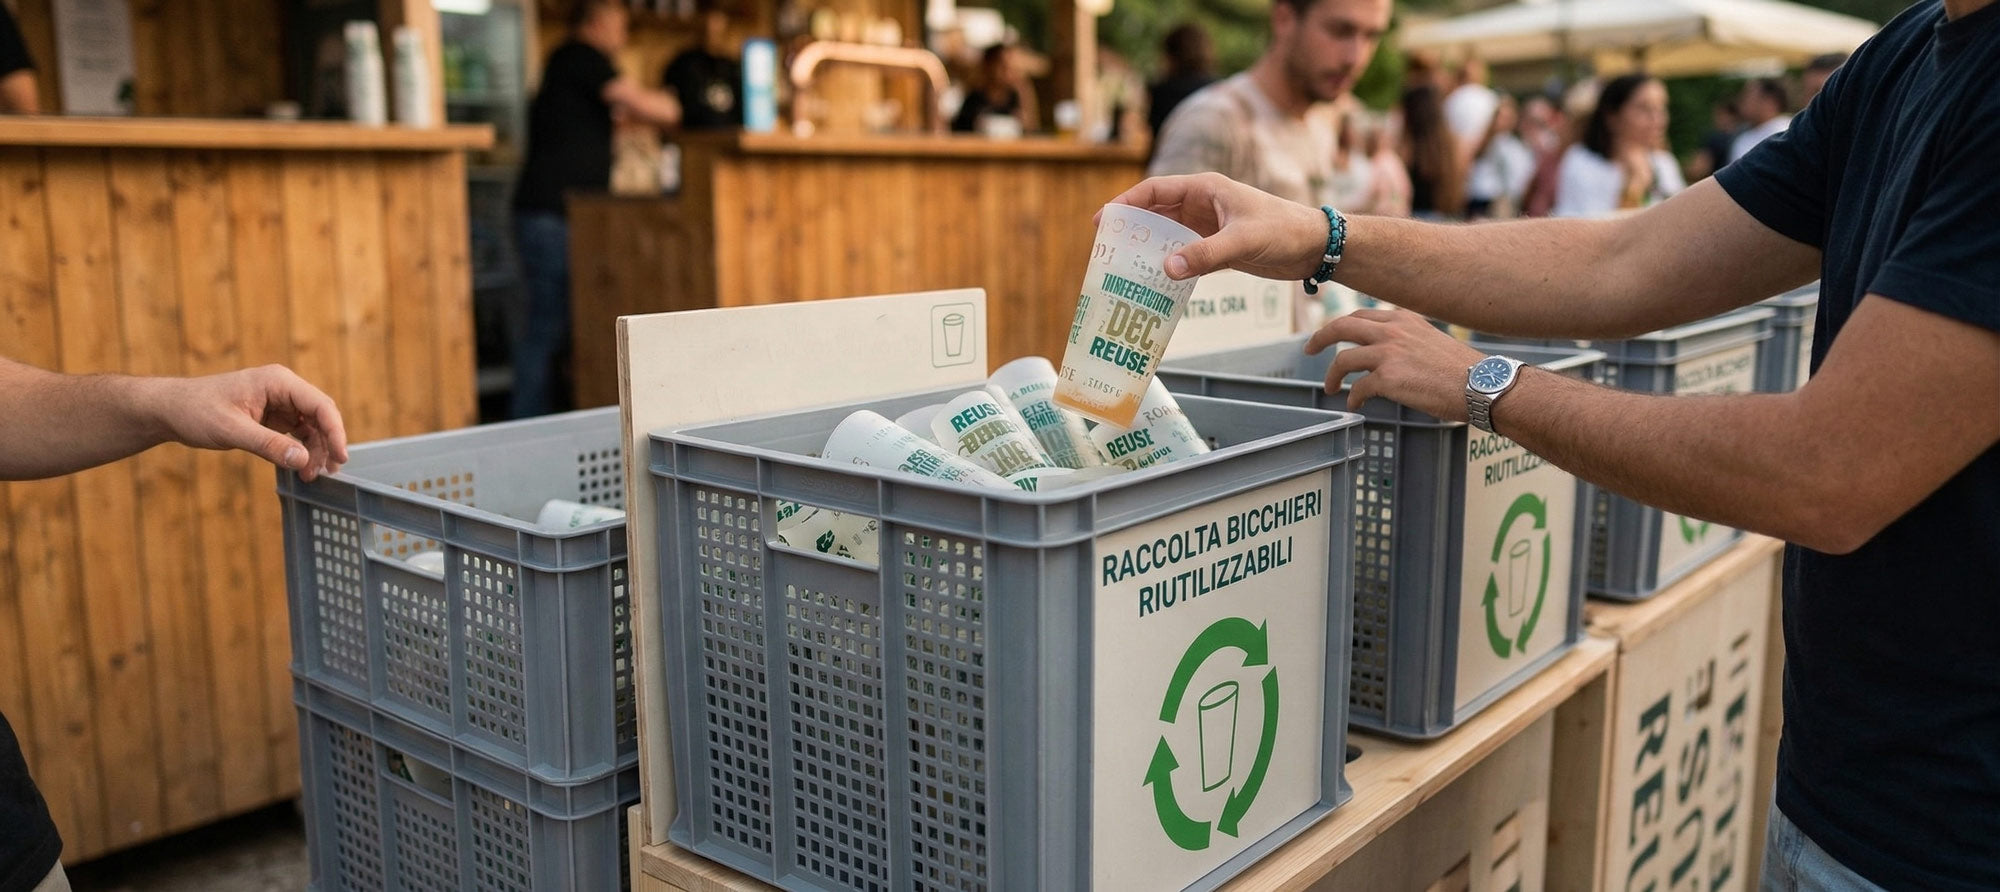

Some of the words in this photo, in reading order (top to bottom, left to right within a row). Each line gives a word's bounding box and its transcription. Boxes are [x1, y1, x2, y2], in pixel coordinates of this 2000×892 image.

[1089, 336, 1150, 376] REUSE
[1106, 428, 1155, 460] REUSE
[1469, 433, 1517, 462] RACCO
[1484, 450, 1547, 488] RIUTILIZZ
[1102, 521, 1222, 587] RACCOLTA
[1227, 489, 1322, 545] BICCHIERI
[1139, 536, 1293, 618] RIUTILIZZABILI
